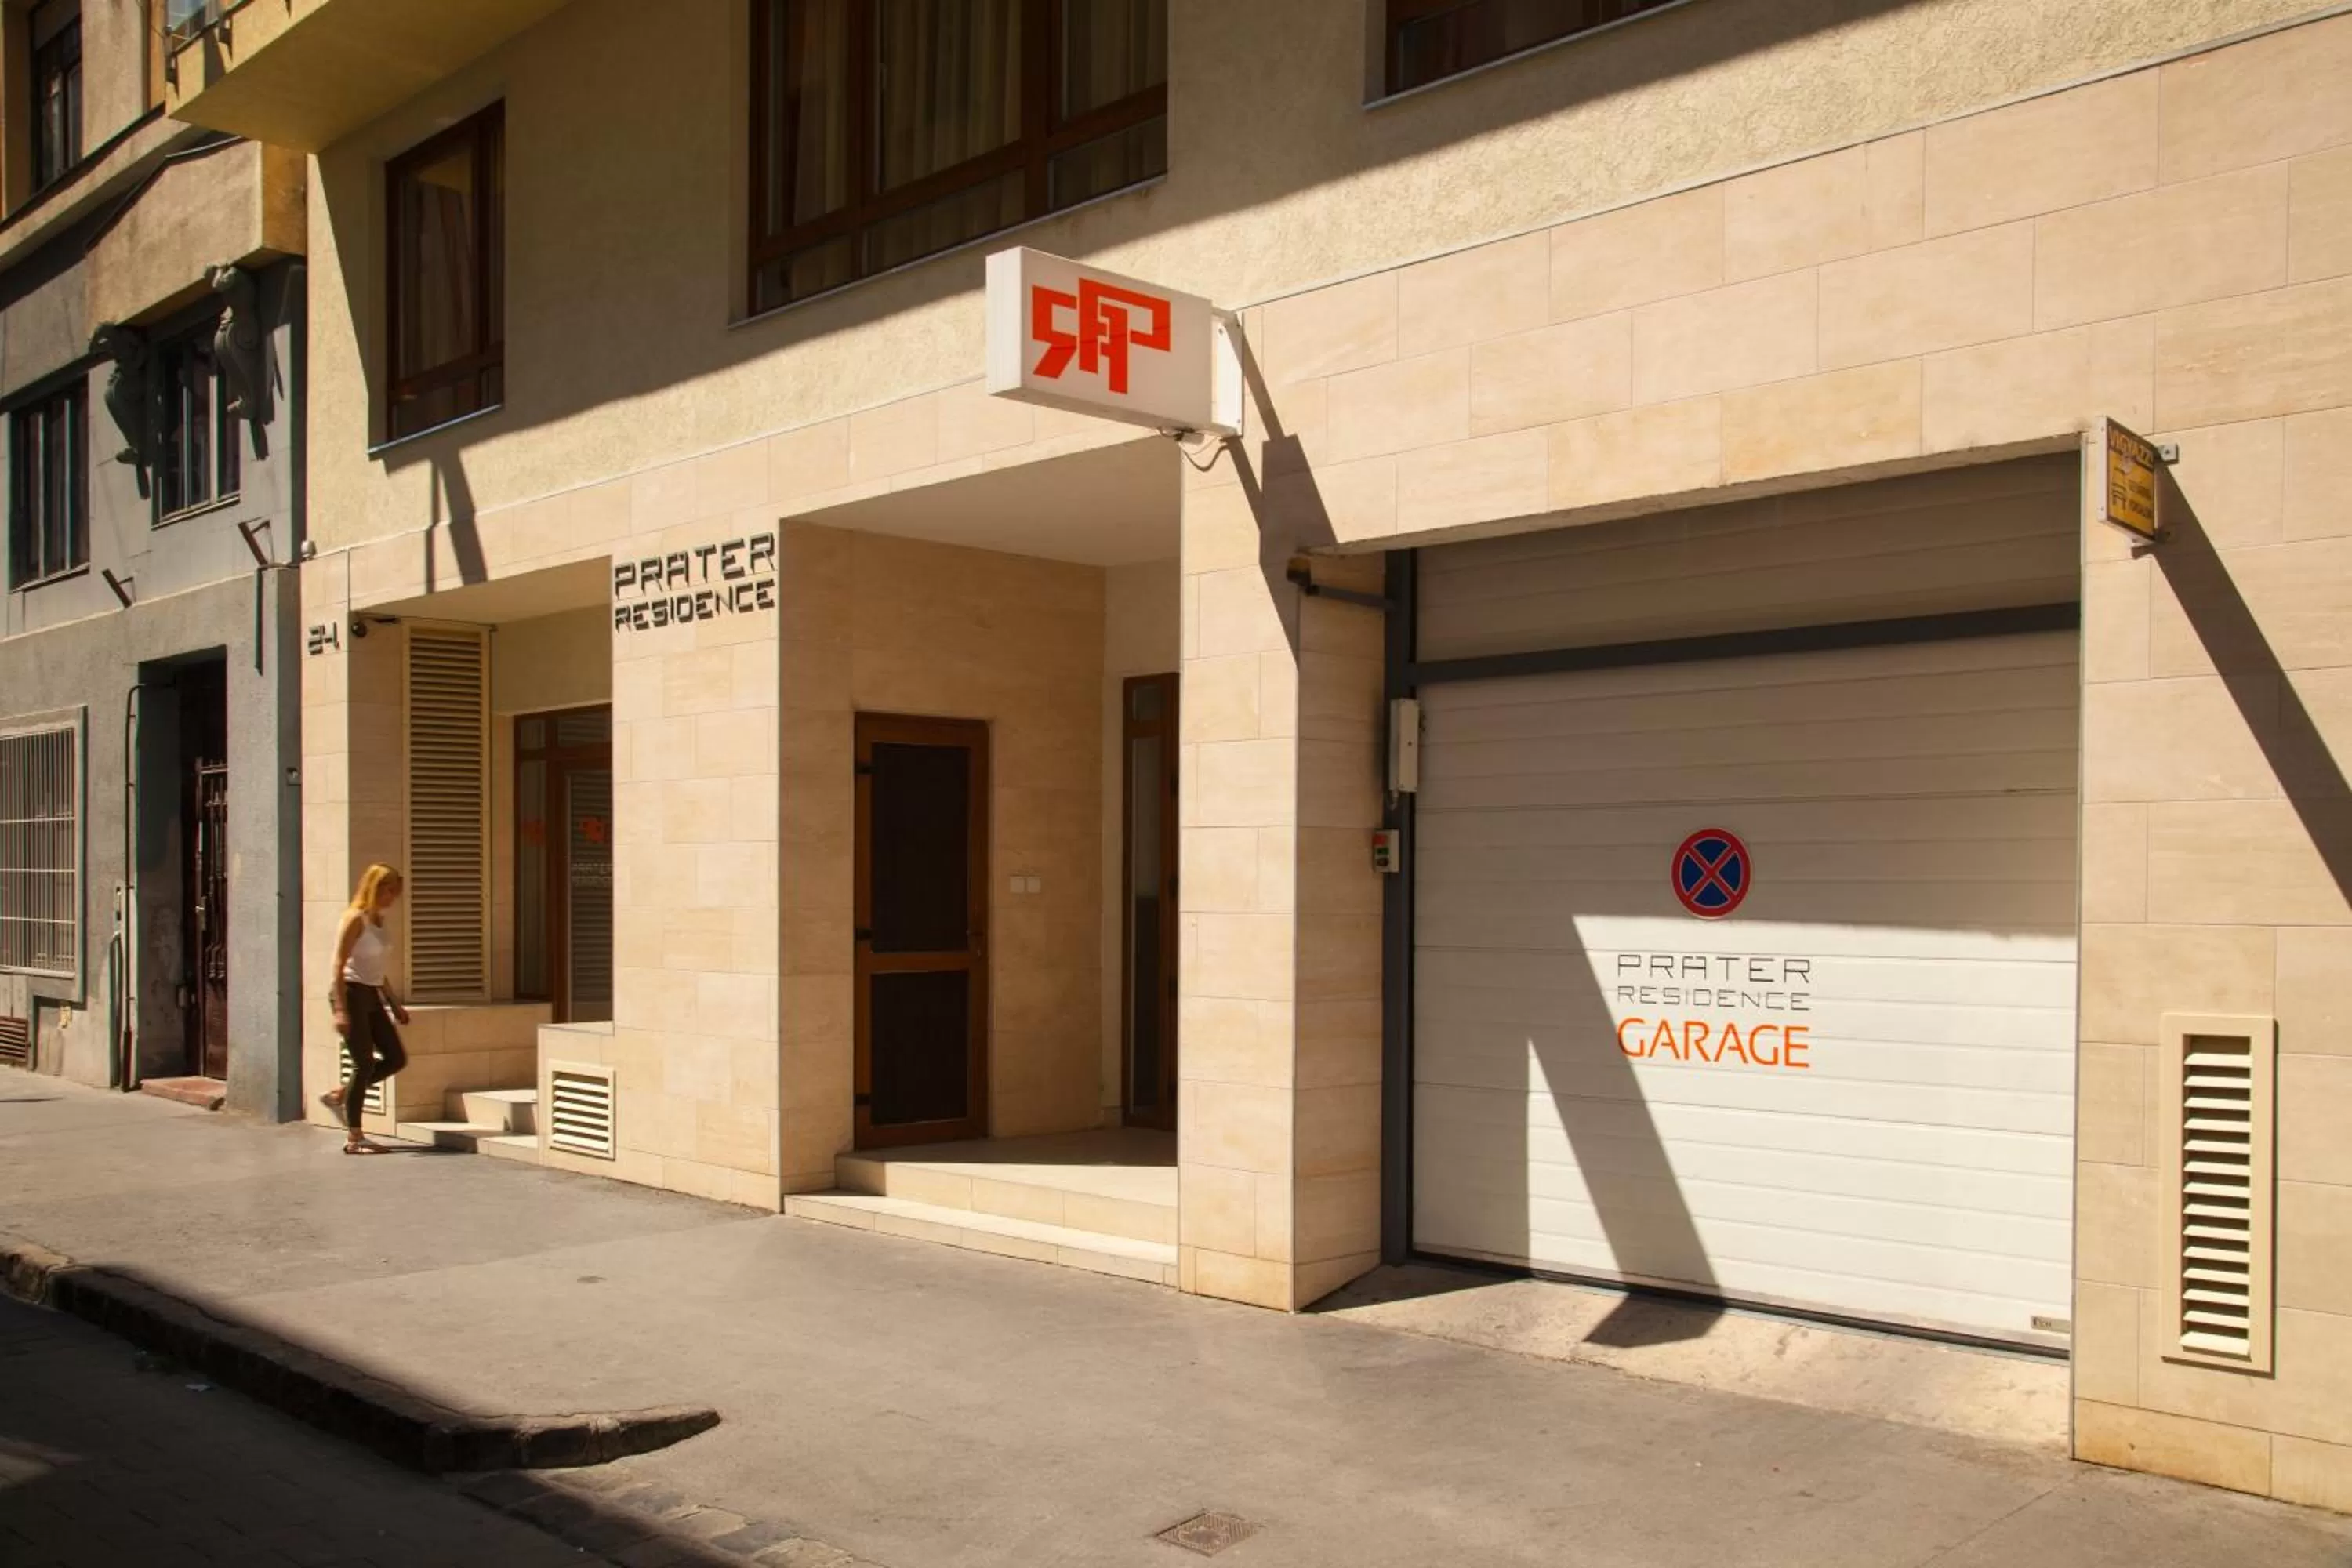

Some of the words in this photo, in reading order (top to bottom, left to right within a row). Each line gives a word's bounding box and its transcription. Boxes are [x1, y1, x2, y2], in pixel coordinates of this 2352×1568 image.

[615, 532, 775, 600] PRATER
[615, 578, 775, 633] RESIDENCE
[1617, 954, 1810, 983] PRATER
[1617, 985, 1810, 1011] RESIDENCE
[1617, 1018, 1809, 1068] GARAGE
